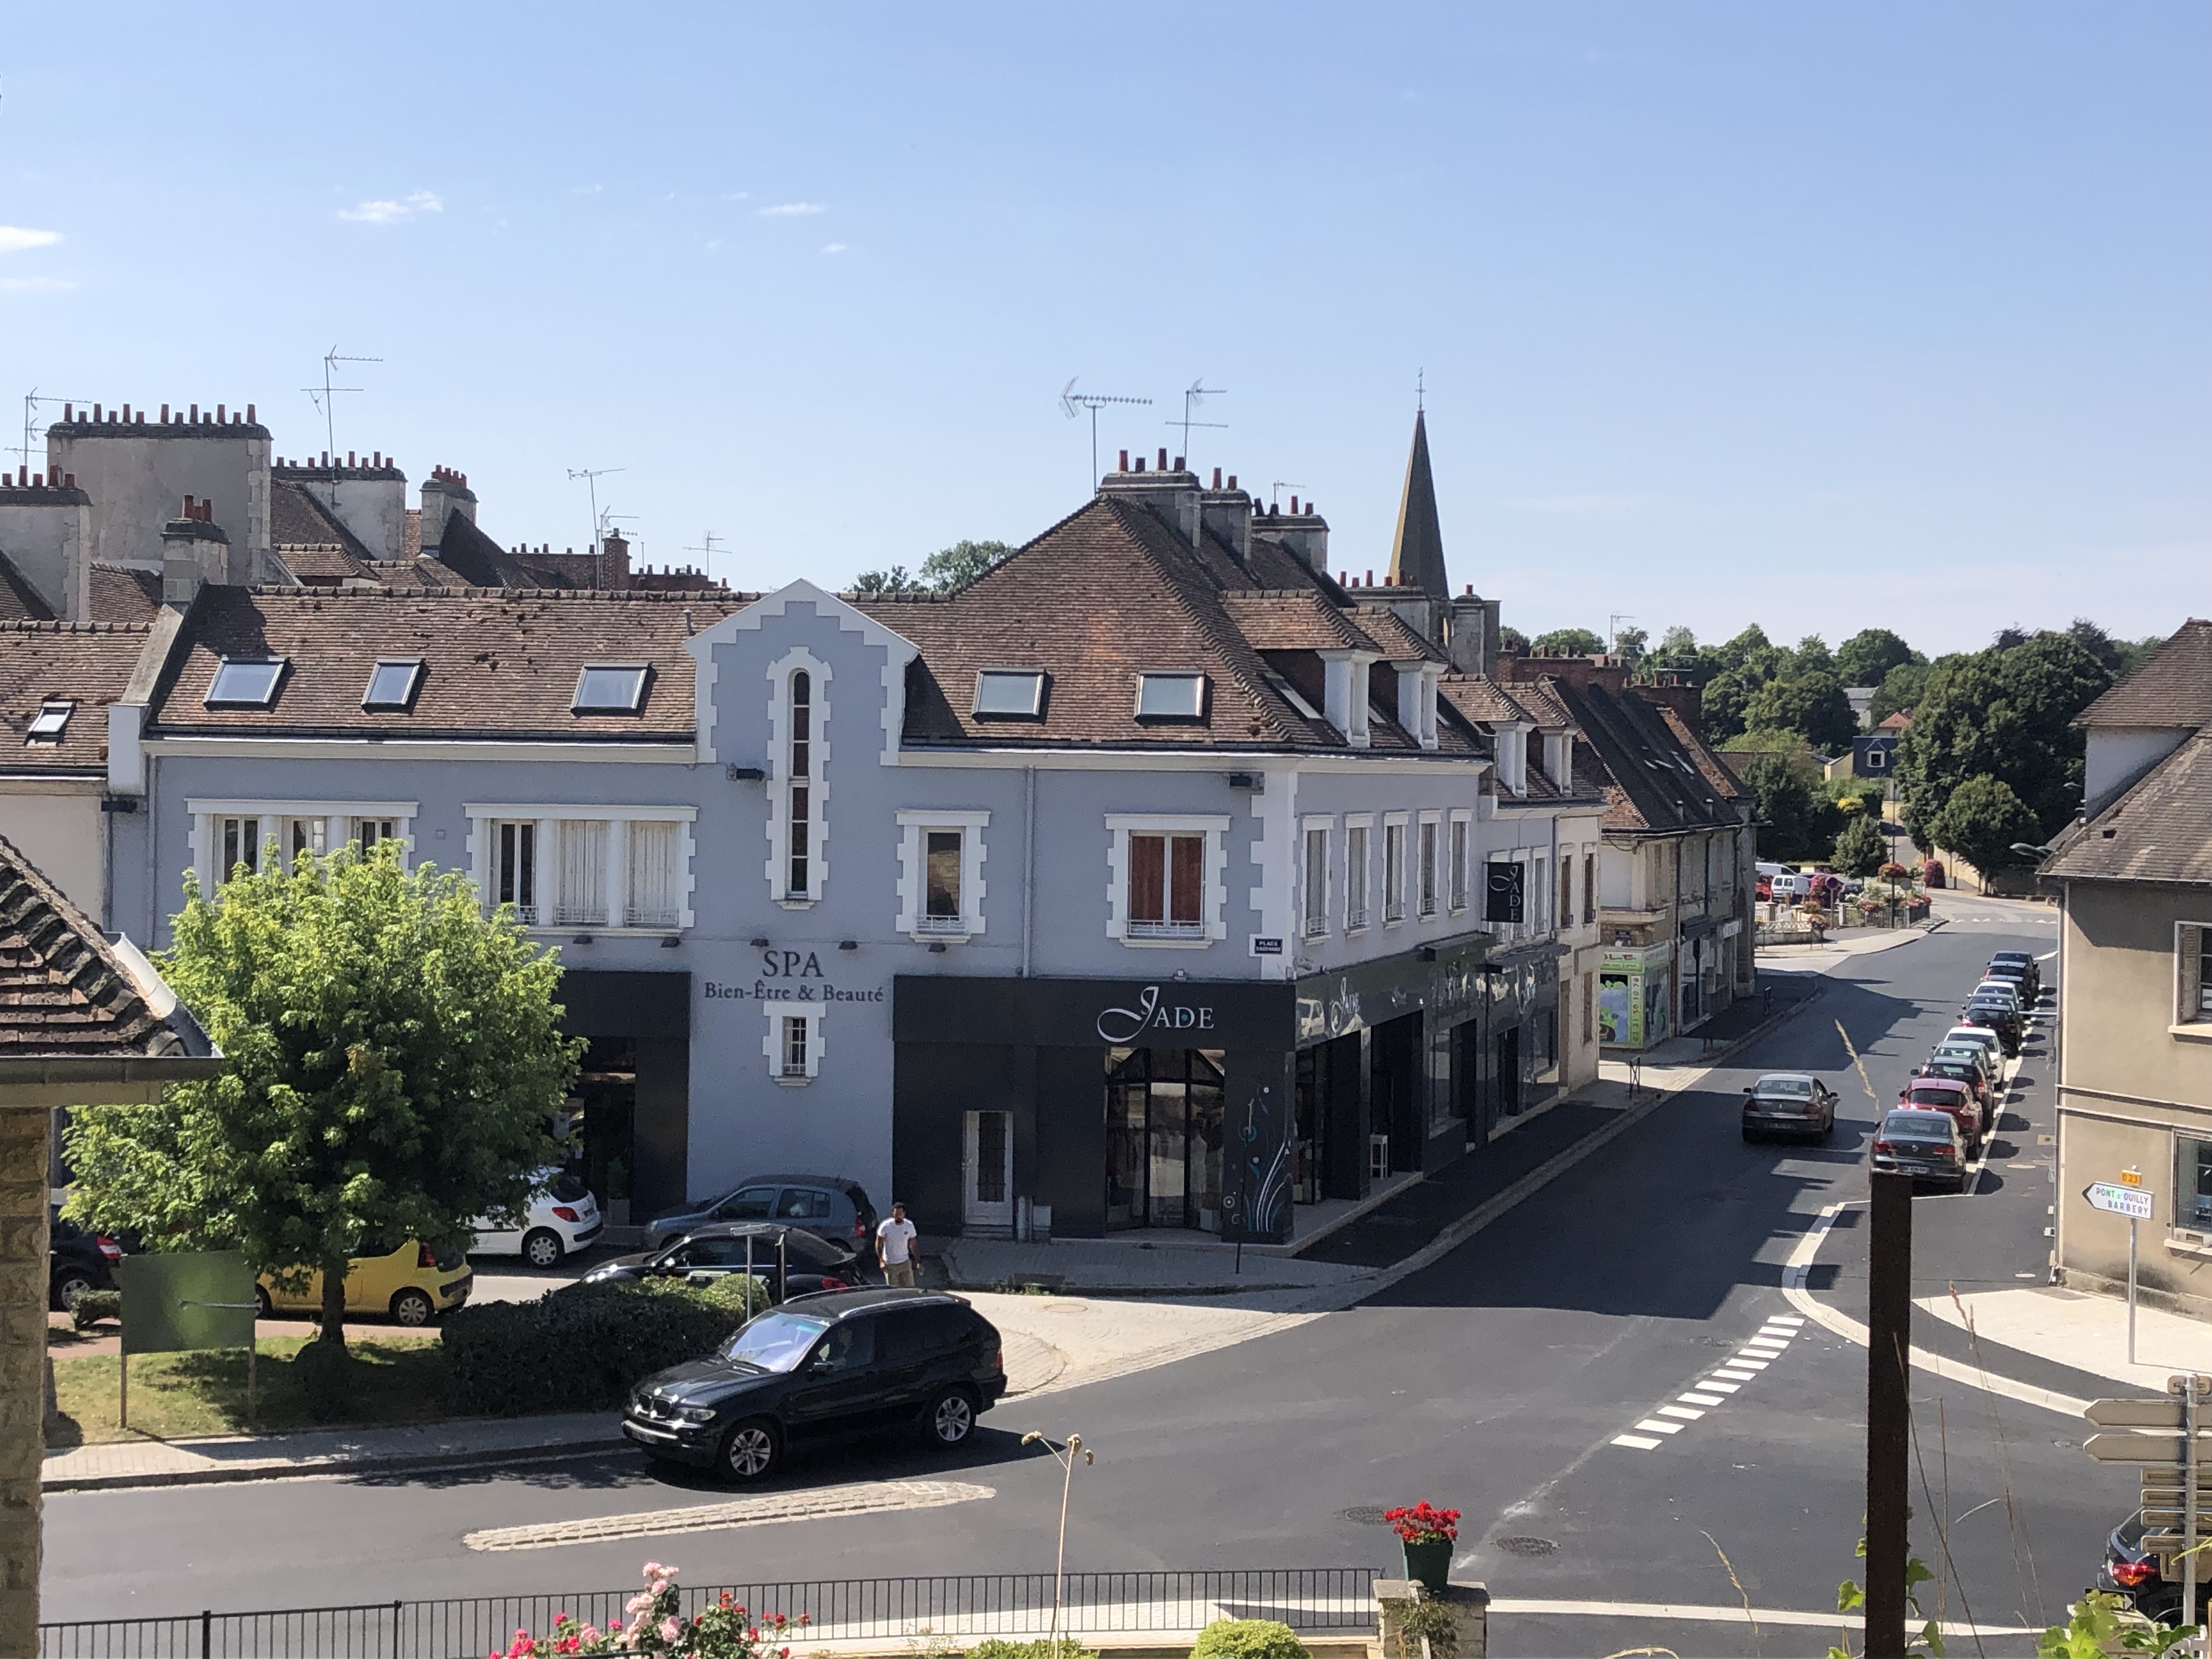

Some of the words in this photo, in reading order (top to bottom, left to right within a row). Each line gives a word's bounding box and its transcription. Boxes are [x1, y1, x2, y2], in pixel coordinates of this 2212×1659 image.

[1489, 866, 1521, 921] JADE
[763, 950, 824, 978] SPA
[704, 979, 791, 1000] Bien-Être
[798, 985, 815, 1001] &
[823, 985, 883, 1002] Beauté
[1097, 986, 1215, 1042] JADE
[2096, 1187, 2115, 1198] PONT
[2108, 1200, 2148, 1215] BARBERY
